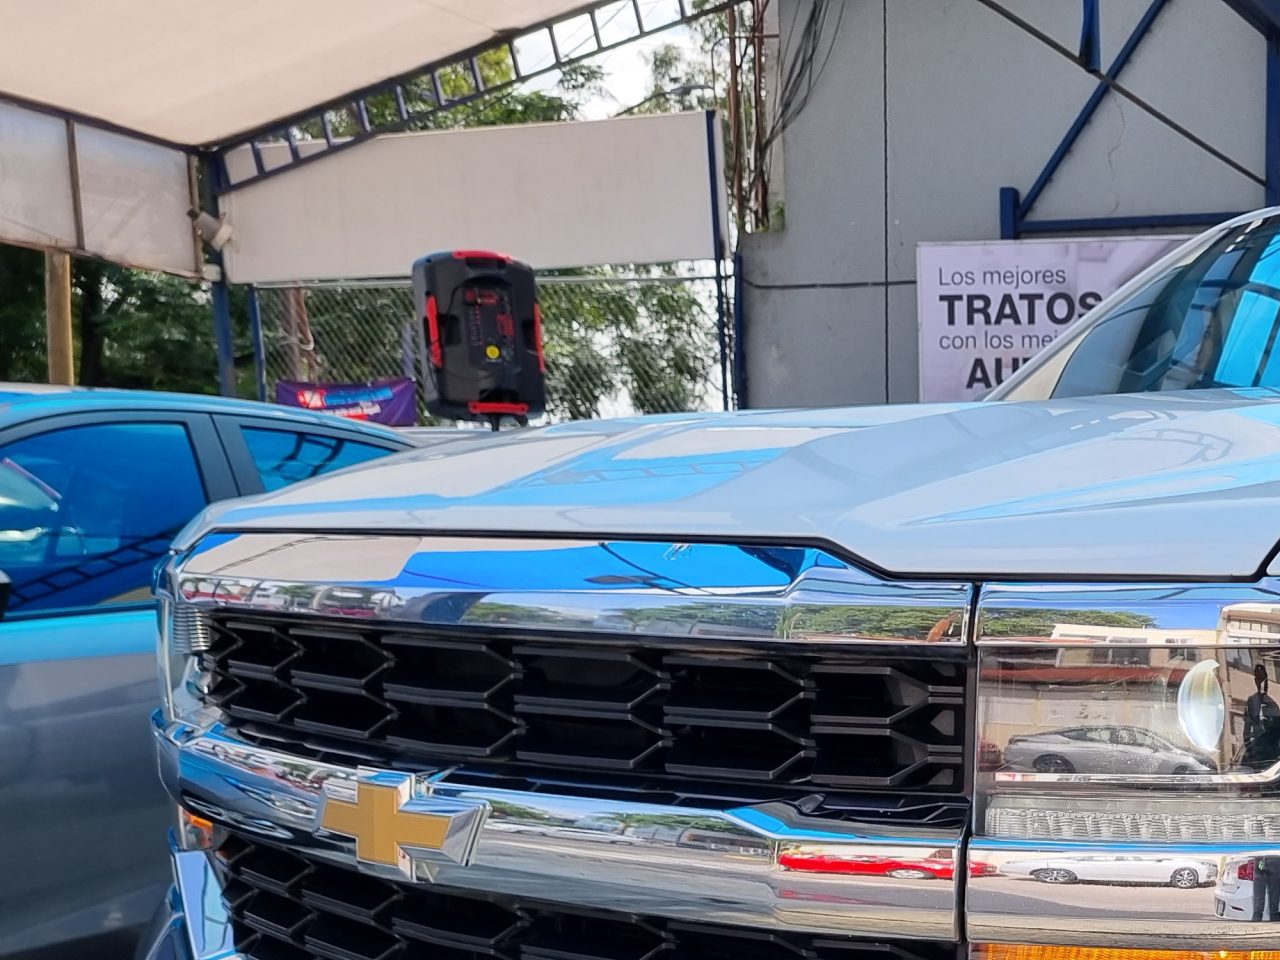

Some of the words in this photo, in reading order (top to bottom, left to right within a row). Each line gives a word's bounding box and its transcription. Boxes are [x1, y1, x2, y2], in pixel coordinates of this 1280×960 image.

[938, 267, 975, 287] Los
[983, 265, 1066, 289] mejores
[939, 291, 1104, 327] TRATOS
[938, 334, 977, 350] con
[984, 330, 1014, 350] los
[965, 357, 1032, 390] AU
